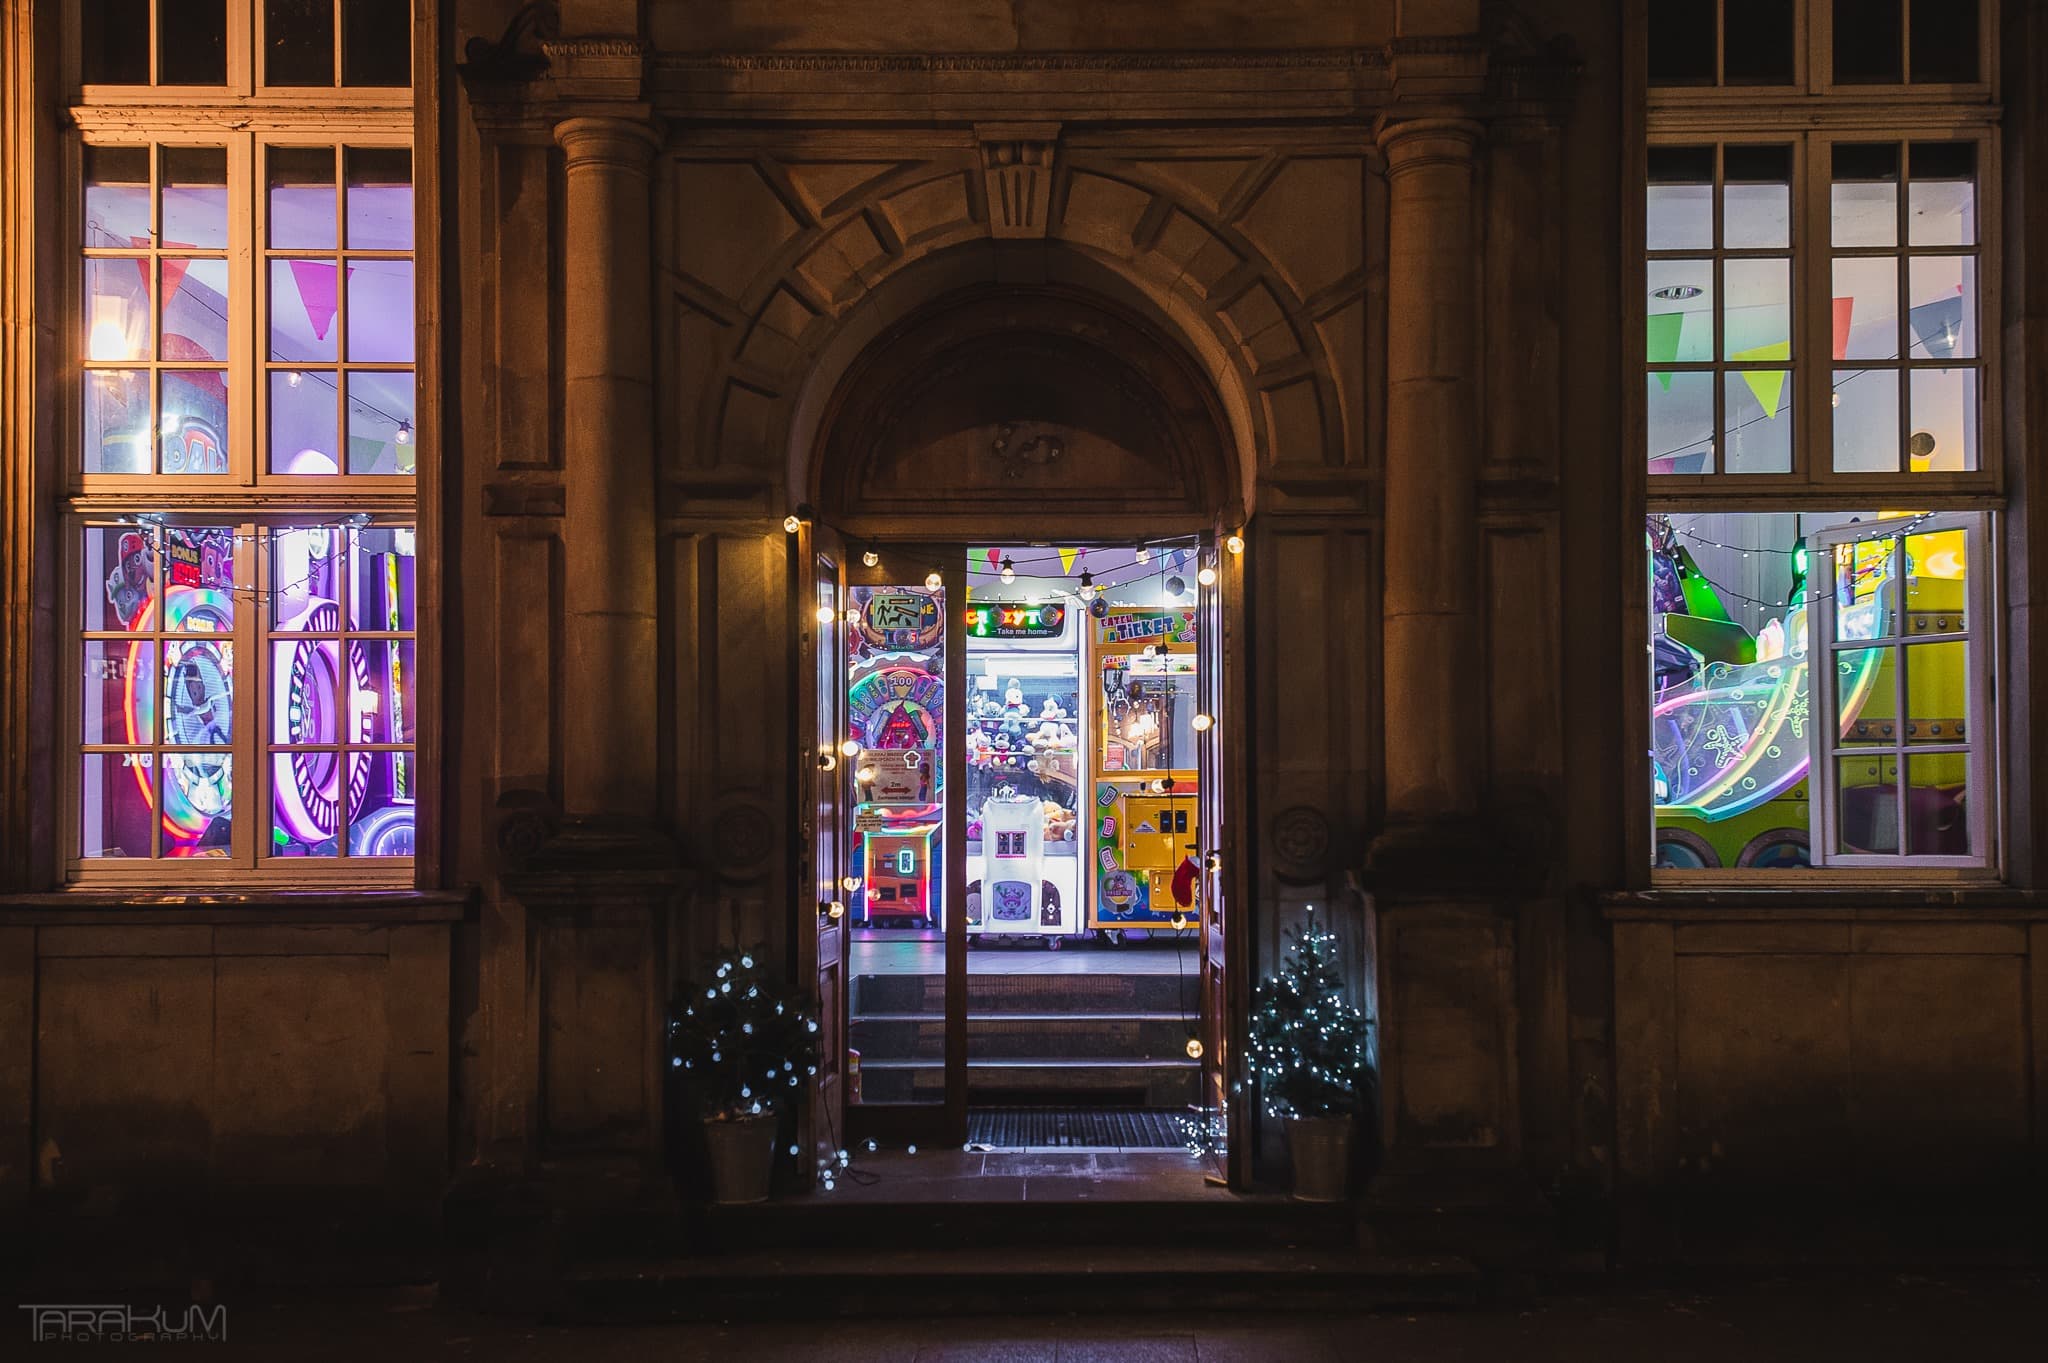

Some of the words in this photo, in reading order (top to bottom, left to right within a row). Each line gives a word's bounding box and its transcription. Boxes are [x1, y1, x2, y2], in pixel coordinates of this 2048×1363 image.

[171, 544, 198, 563] BONUS
[1101, 614, 1132, 627] CATCH
[1109, 631, 1116, 641] A
[893, 676, 912, 686] 100
